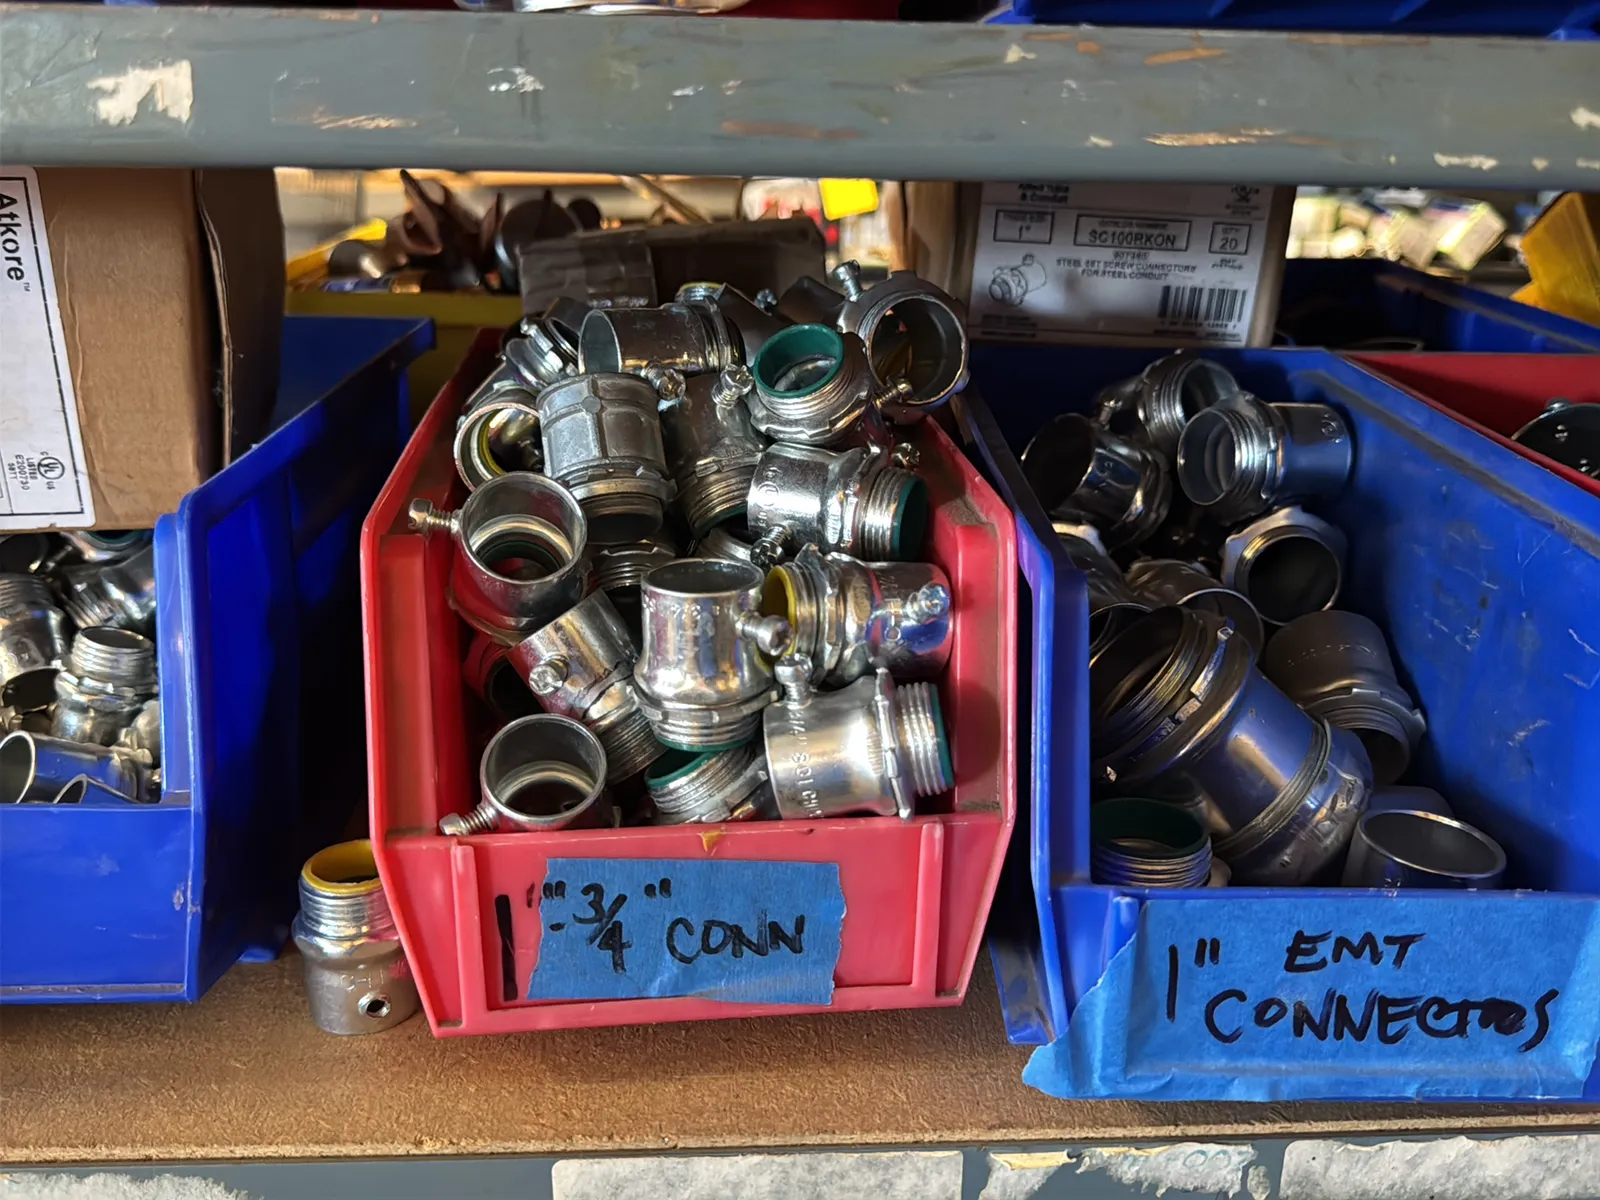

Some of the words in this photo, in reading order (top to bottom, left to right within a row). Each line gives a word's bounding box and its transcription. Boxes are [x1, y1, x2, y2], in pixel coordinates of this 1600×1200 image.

[1220, 237, 1238, 250] 20
[26, 457, 38, 480] LISTED
[666, 908, 805, 964] CONN
[1166, 938, 1220, 1022] 1"
[1283, 929, 1426, 974] EMT
